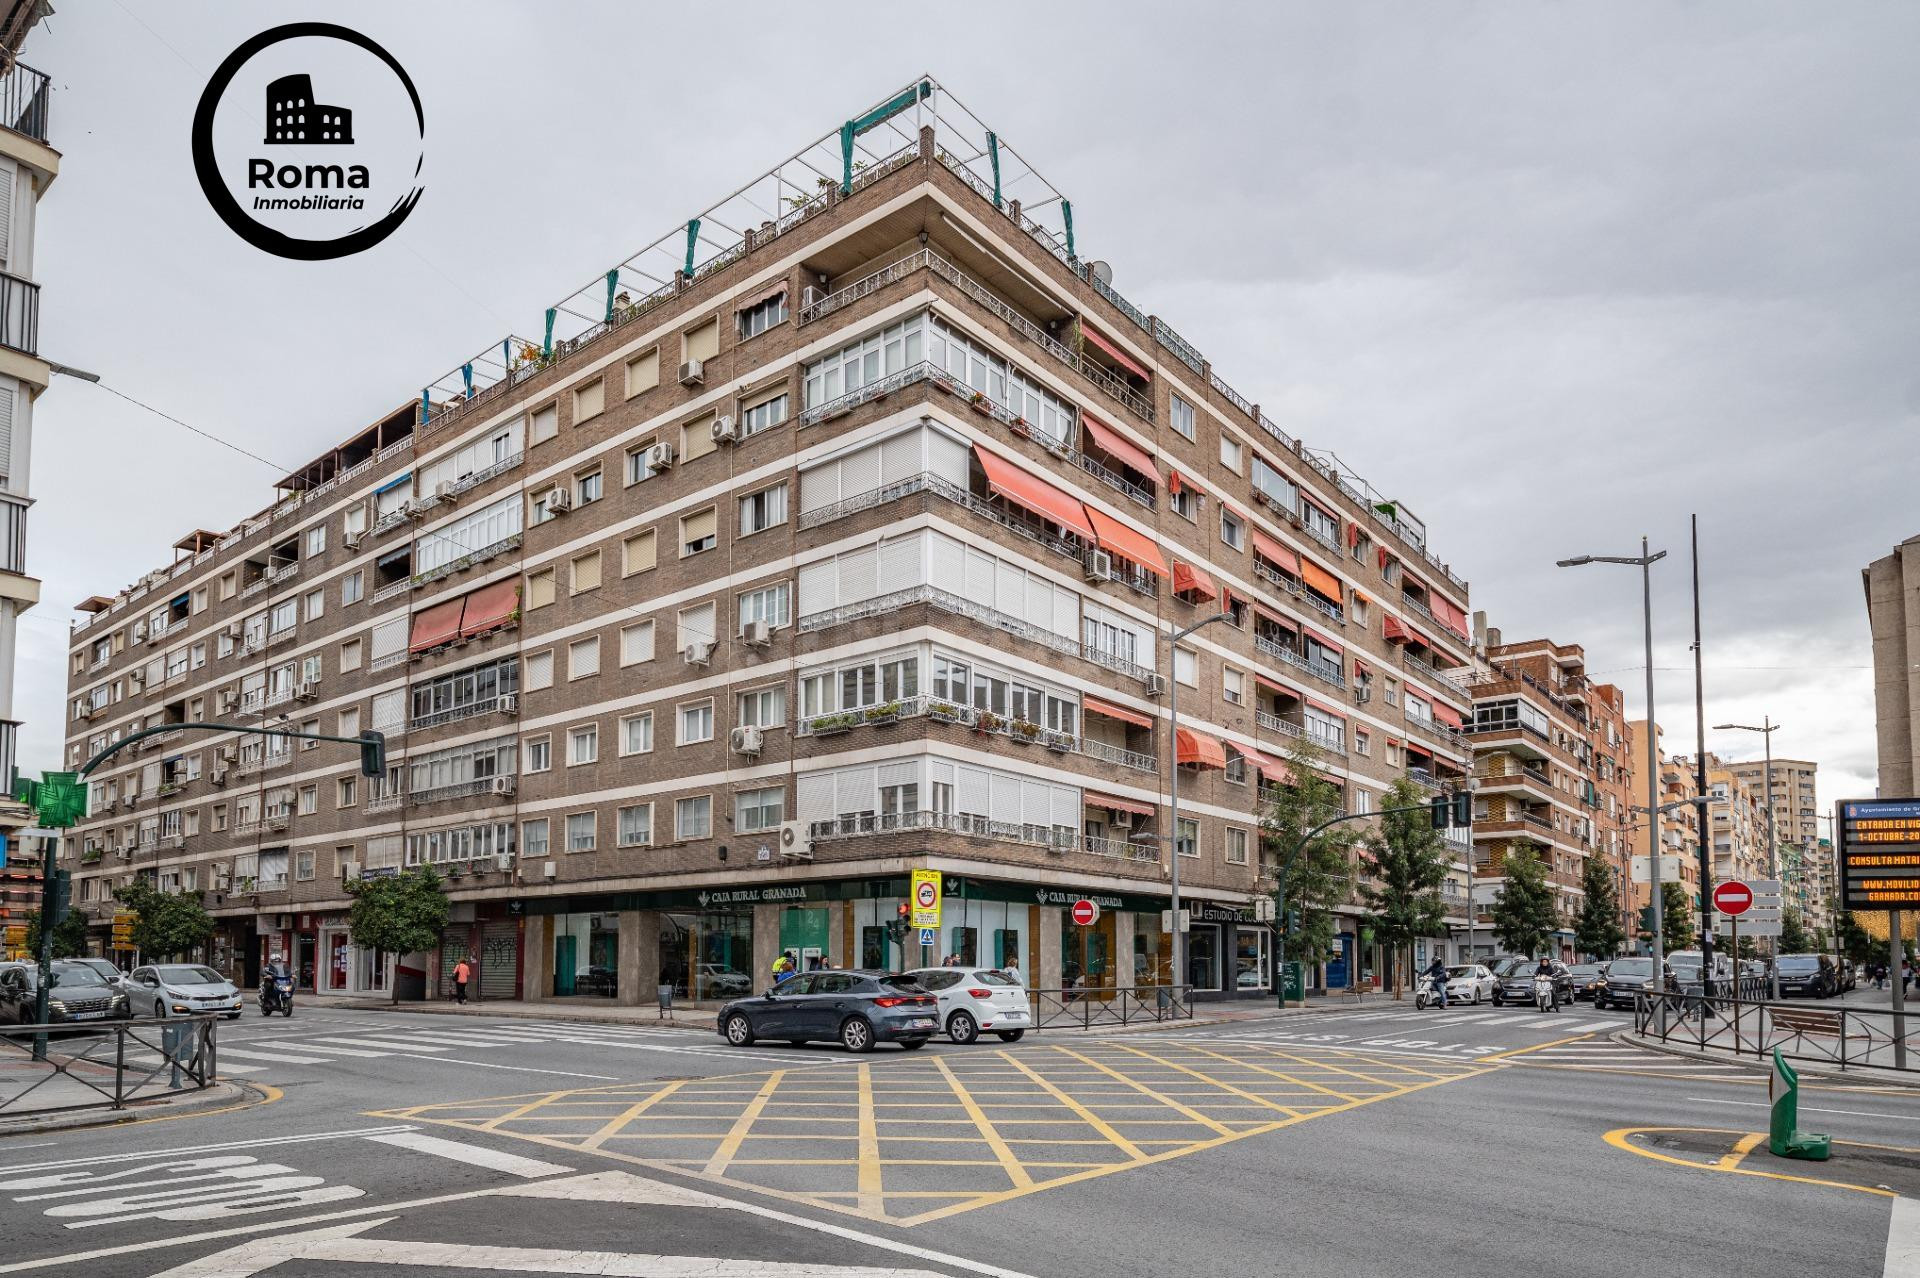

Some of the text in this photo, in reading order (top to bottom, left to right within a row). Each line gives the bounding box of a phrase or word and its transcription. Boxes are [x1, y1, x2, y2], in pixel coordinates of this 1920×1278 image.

[1857, 820, 1894, 829] ENTRADA
[1895, 820, 1906, 829] EN
[1850, 856, 1893, 865] CONSULTA
[711, 887, 806, 902] CAJA RURAL GRANADA
[1049, 891, 1066, 902] CAJA
[1869, 892, 1920, 901] GRANADA.CO
[1204, 909, 1233, 921] ESTUDIO
[1233, 911, 1243, 922] DE
[0, 1155, 368, 1230] STOP
